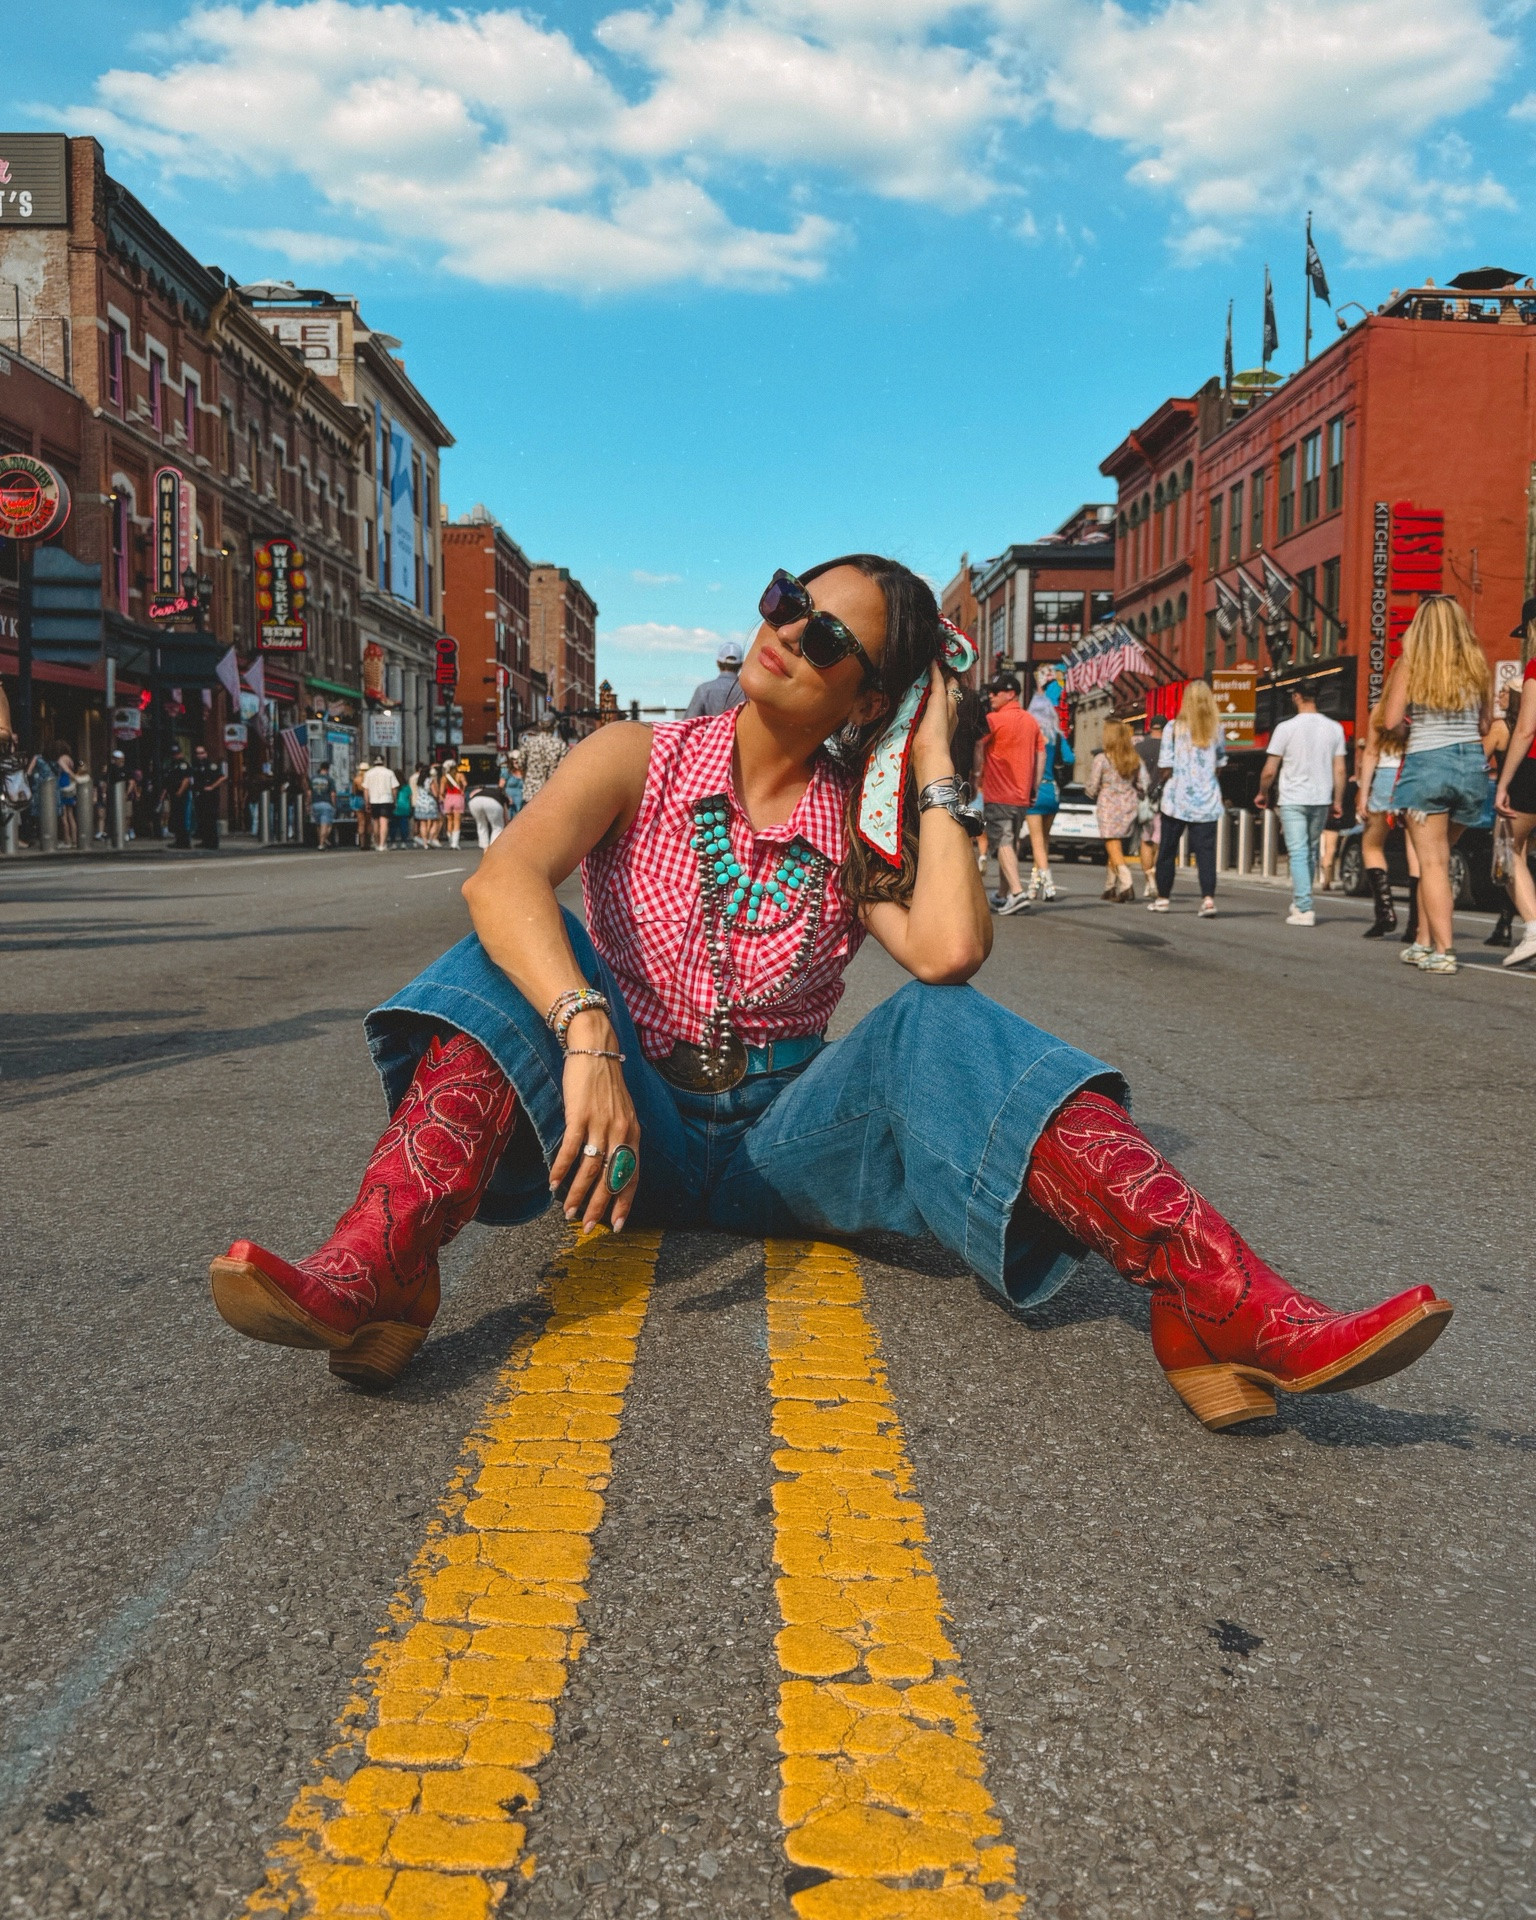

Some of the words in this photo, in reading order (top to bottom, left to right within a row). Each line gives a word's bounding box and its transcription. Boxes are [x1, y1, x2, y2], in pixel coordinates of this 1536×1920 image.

[160, 477, 173, 588] MIRANDA
[1373, 502, 1388, 576] KITCHEN
[1391, 502, 1444, 592] JASON
[271, 544, 289, 625] WHISKEY
[262, 626, 303, 638] BENT
[435, 638, 456, 684] OLE
[1370, 588, 1387, 672] ROOFTOP
